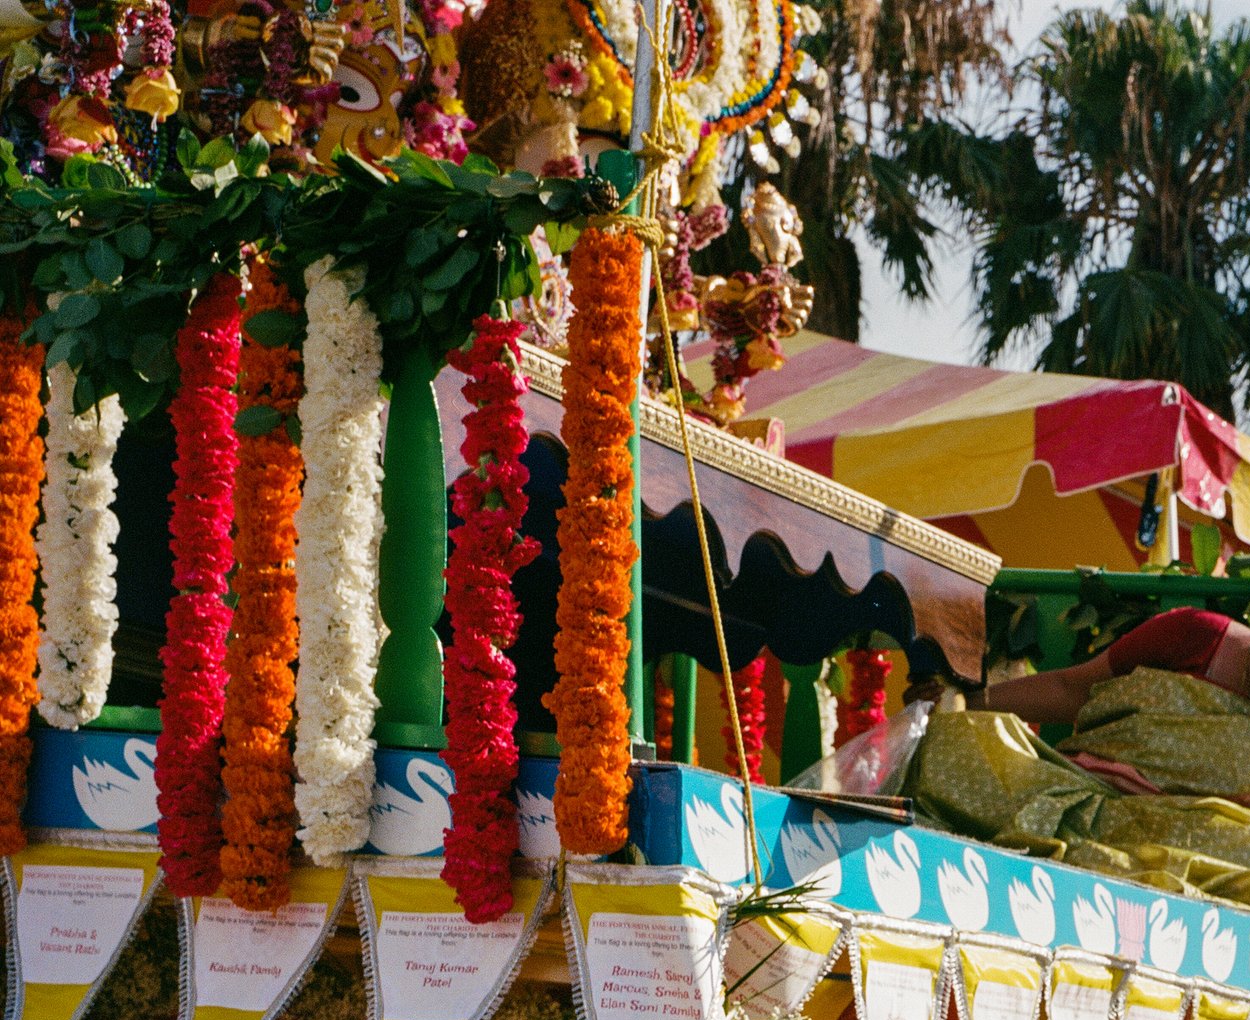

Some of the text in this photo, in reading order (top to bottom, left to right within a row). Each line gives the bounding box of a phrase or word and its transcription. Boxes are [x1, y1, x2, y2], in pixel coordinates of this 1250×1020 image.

[208, 961, 282, 979] Kaushik Family
[405, 960, 479, 974] Tanuj Kumar
[423, 977, 452, 988] Patel
[655, 986, 690, 1000] Sneha
[694, 988, 702, 1001] &
[600, 997, 701, 1020] Elan Soni Family
